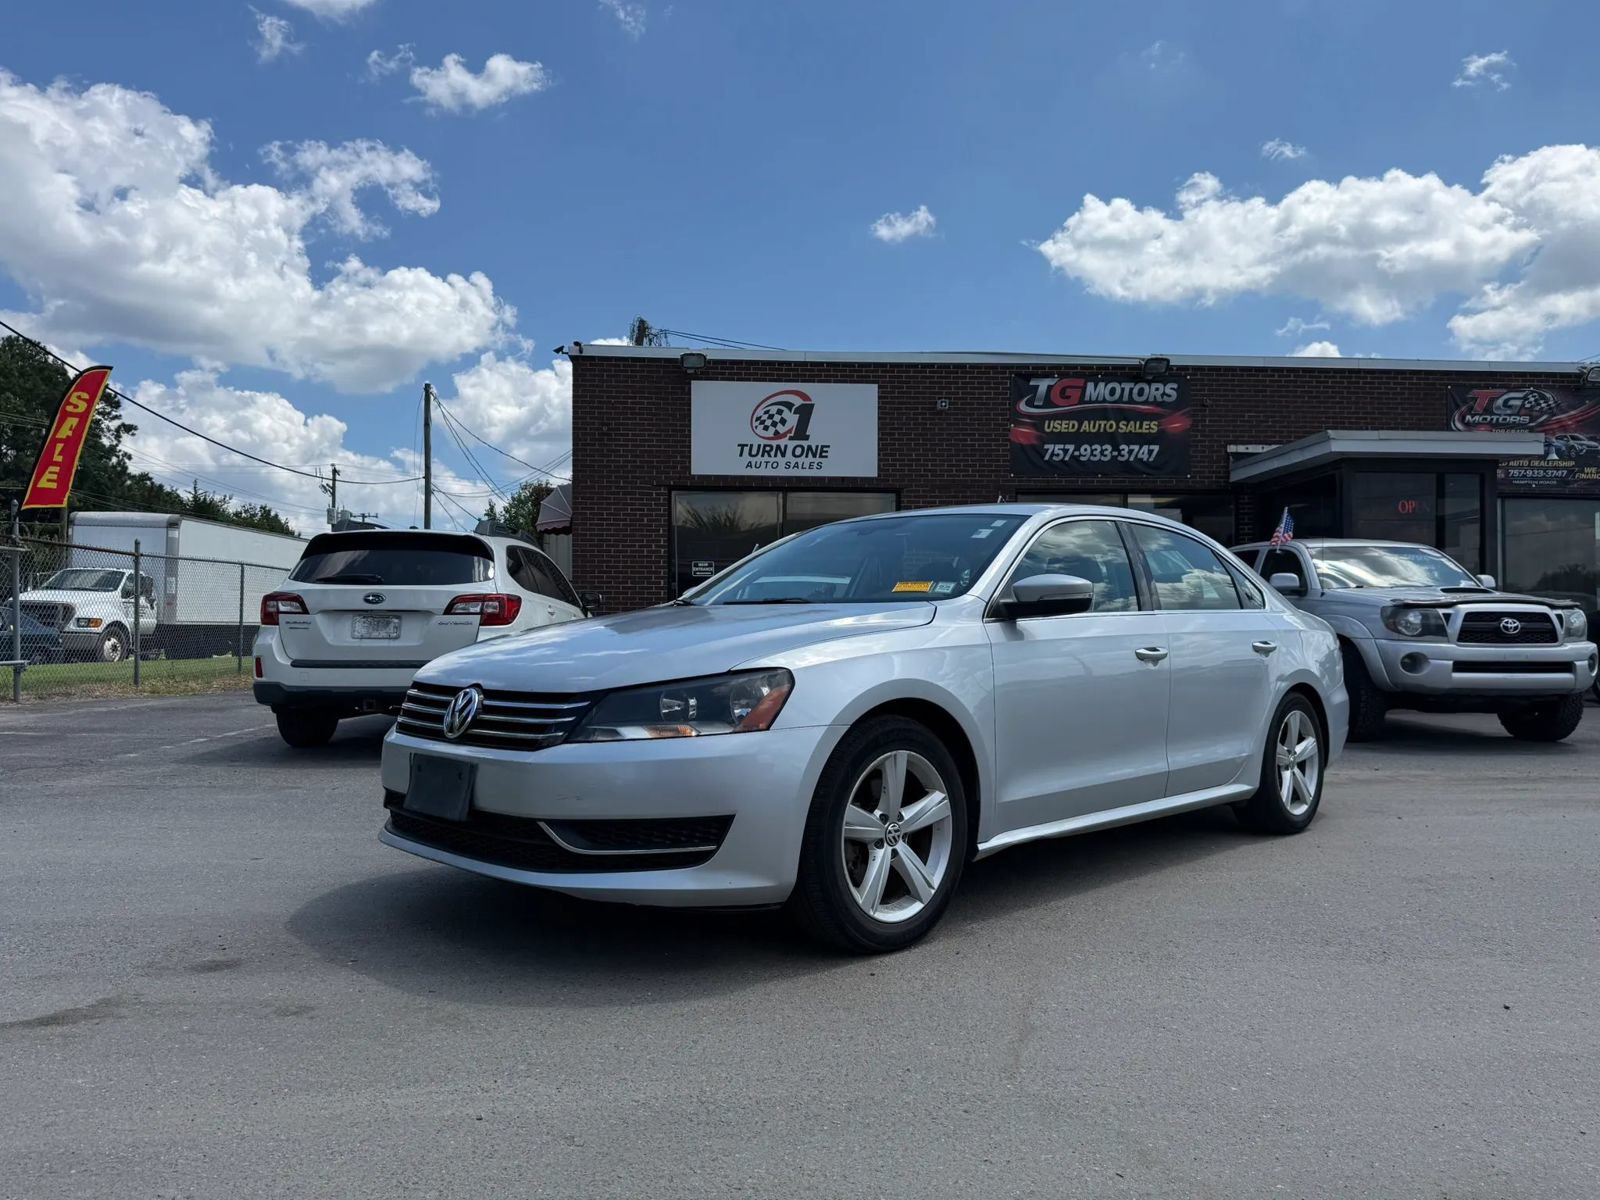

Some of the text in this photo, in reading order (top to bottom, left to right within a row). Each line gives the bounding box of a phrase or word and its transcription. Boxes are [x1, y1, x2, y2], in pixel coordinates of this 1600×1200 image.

[1029, 378, 1178, 406] TG MOTORS
[788, 403, 815, 441] 1
[1044, 420, 1159, 433] USED AUTO SALES
[1465, 415, 1529, 424] MOTORS
[36, 391, 89, 489] SALE
[737, 443, 831, 459] TURN ONE
[1043, 444, 1160, 461] 757-933-3747
[745, 461, 823, 470] AUTO SALES
